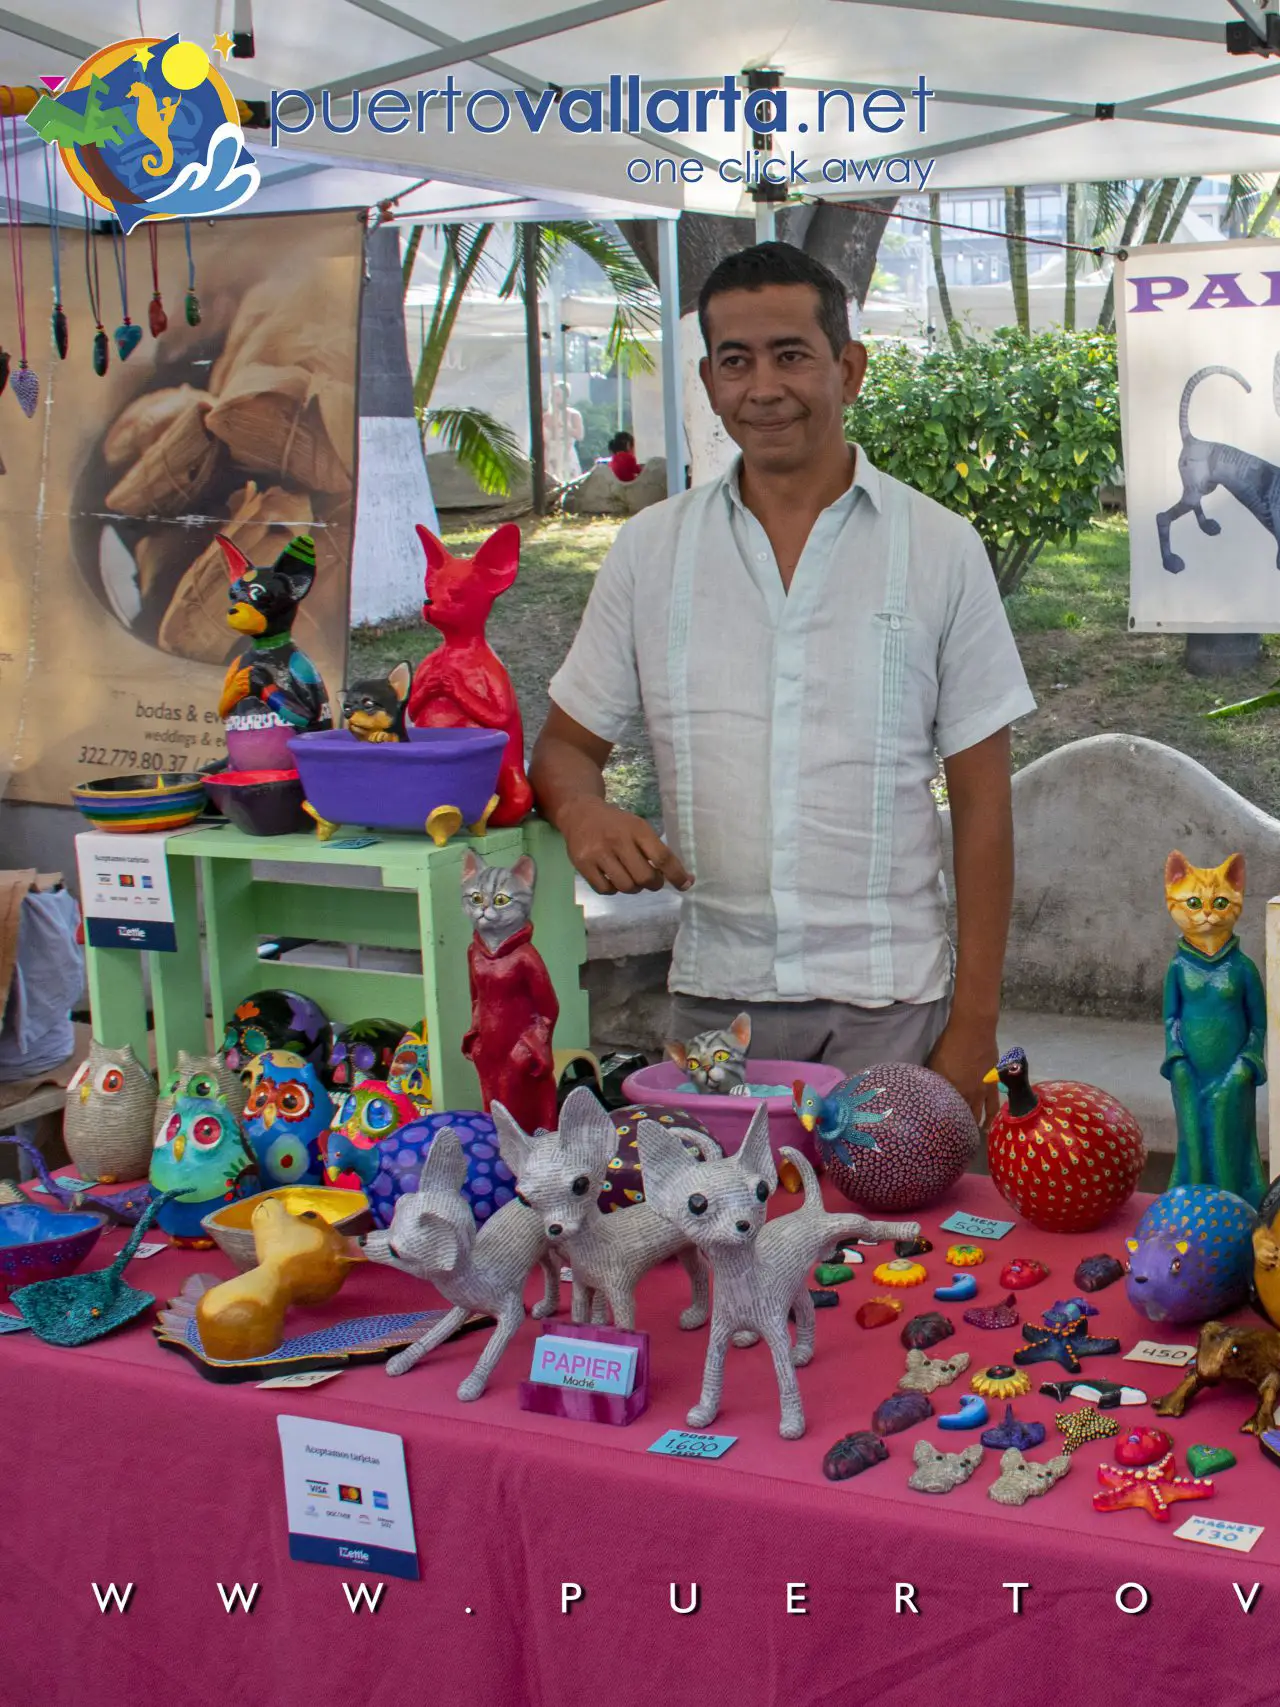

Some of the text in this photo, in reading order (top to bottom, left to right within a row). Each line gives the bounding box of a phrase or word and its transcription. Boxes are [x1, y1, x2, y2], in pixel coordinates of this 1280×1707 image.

[135, 702, 182, 720] bodas
[186, 704, 198, 722] &
[144, 729, 197, 748] weddings
[78, 746, 188, 772] 322.779.80.37
[953, 1220, 995, 1235] 500
[971, 1216, 998, 1227] HEN
[1142, 1347, 1188, 1359] 450
[541, 1350, 623, 1382] PAPIER
[679, 1431, 716, 1441] DOGS
[310, 1485, 327, 1495] VISA
[1193, 1518, 1257, 1535] MAGNET
[1195, 1528, 1239, 1542] 130
